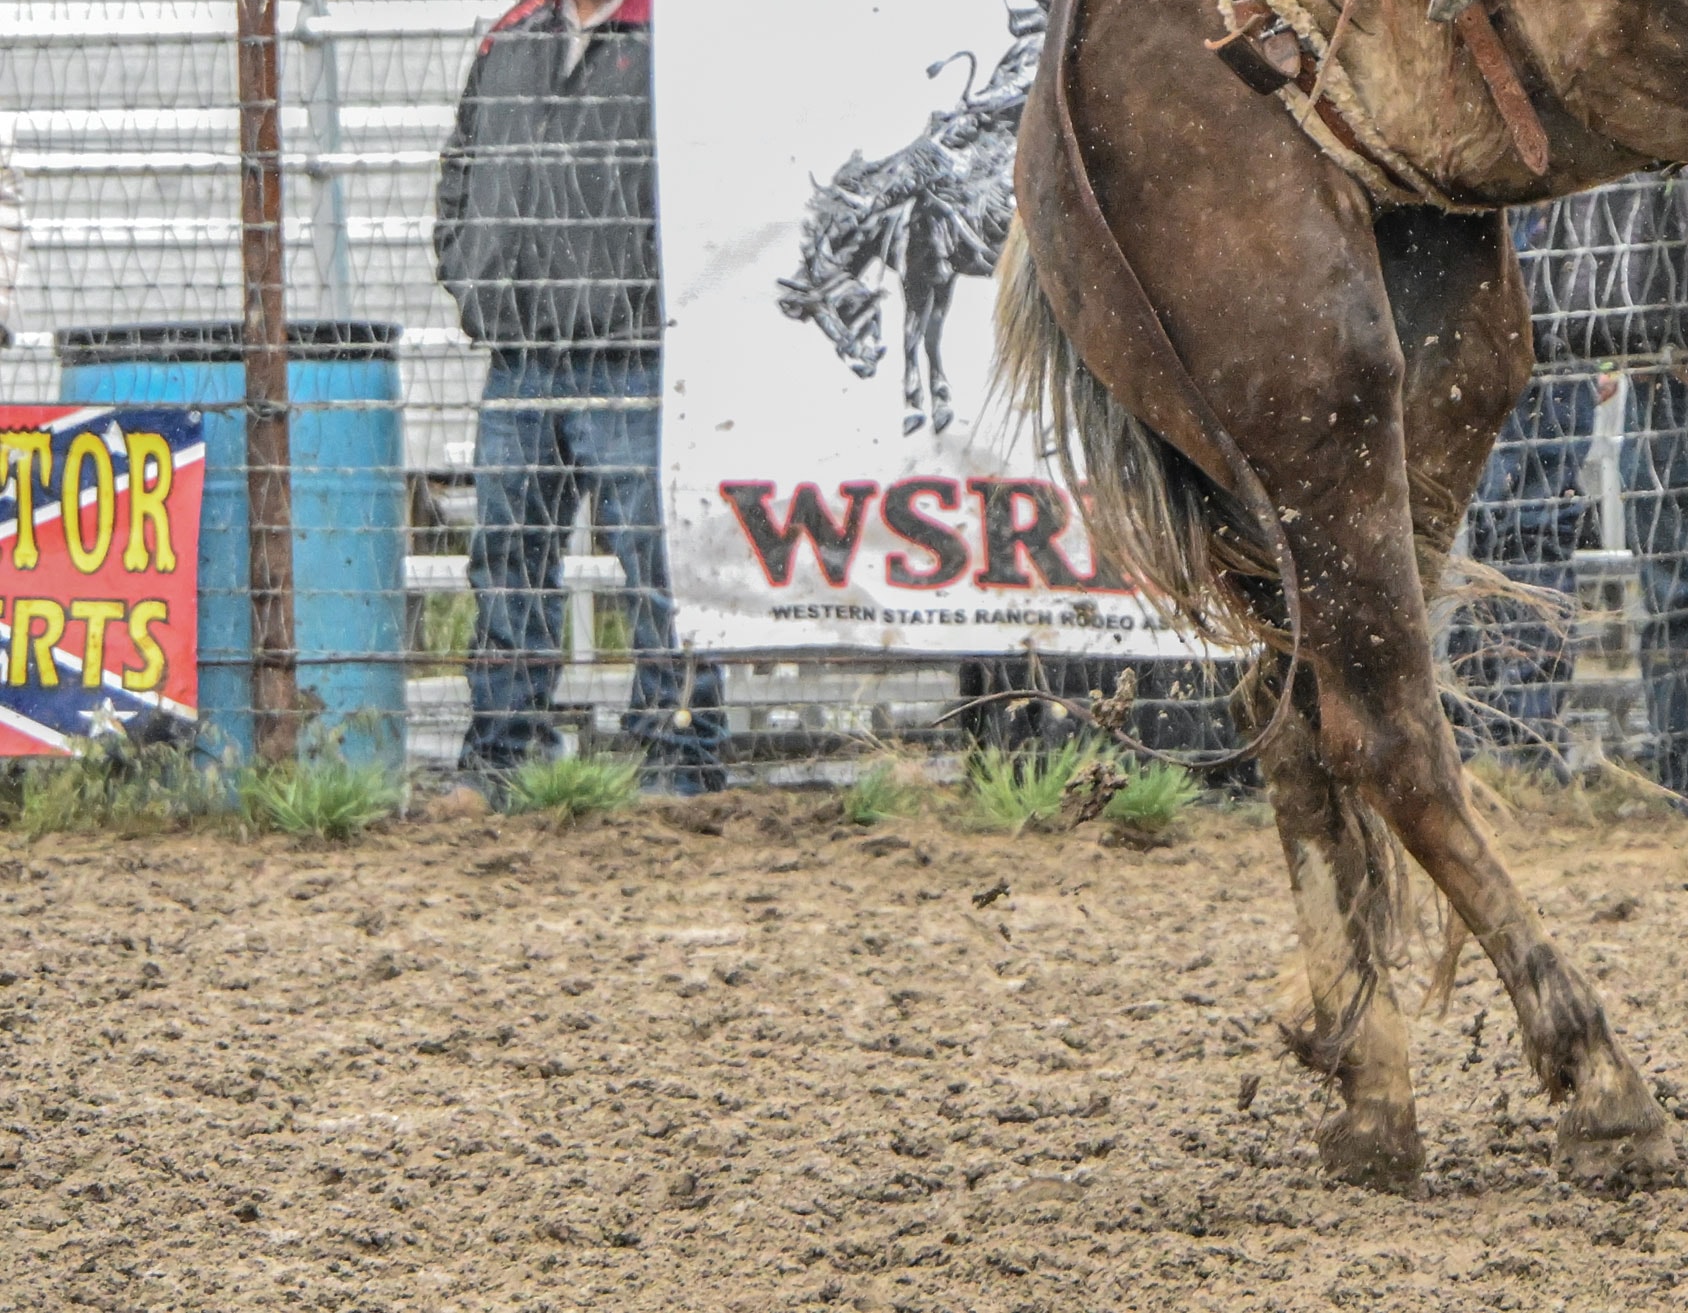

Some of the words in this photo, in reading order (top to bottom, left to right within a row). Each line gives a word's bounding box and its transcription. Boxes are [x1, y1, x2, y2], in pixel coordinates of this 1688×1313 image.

[771, 603, 876, 622] WESTERN
[882, 607, 968, 625] STATES
[974, 608, 1053, 626] RANCH
